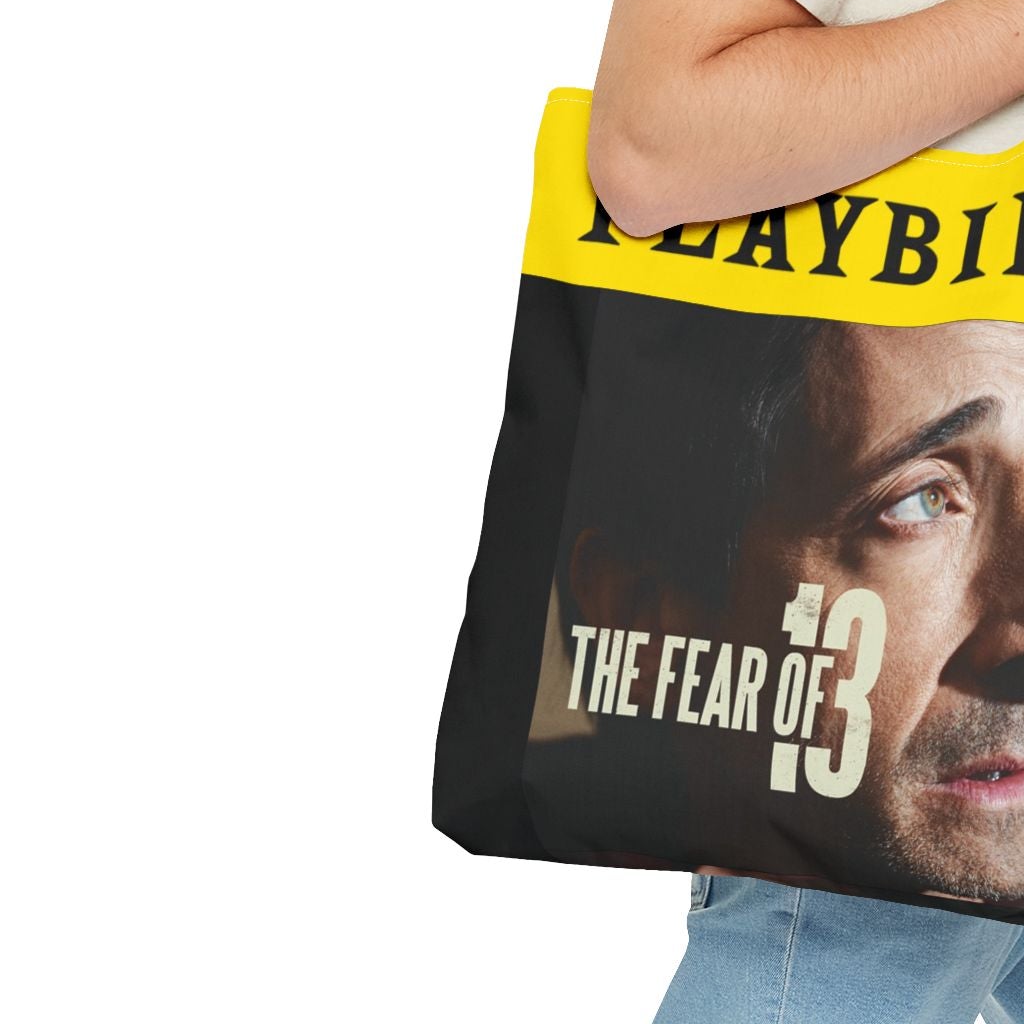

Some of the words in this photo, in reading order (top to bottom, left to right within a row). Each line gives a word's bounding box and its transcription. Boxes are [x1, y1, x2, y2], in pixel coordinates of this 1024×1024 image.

[567, 624, 650, 717] THE
[651, 634, 768, 733] FEAR
[770, 582, 888, 799] 13
[772, 651, 835, 740] OF
